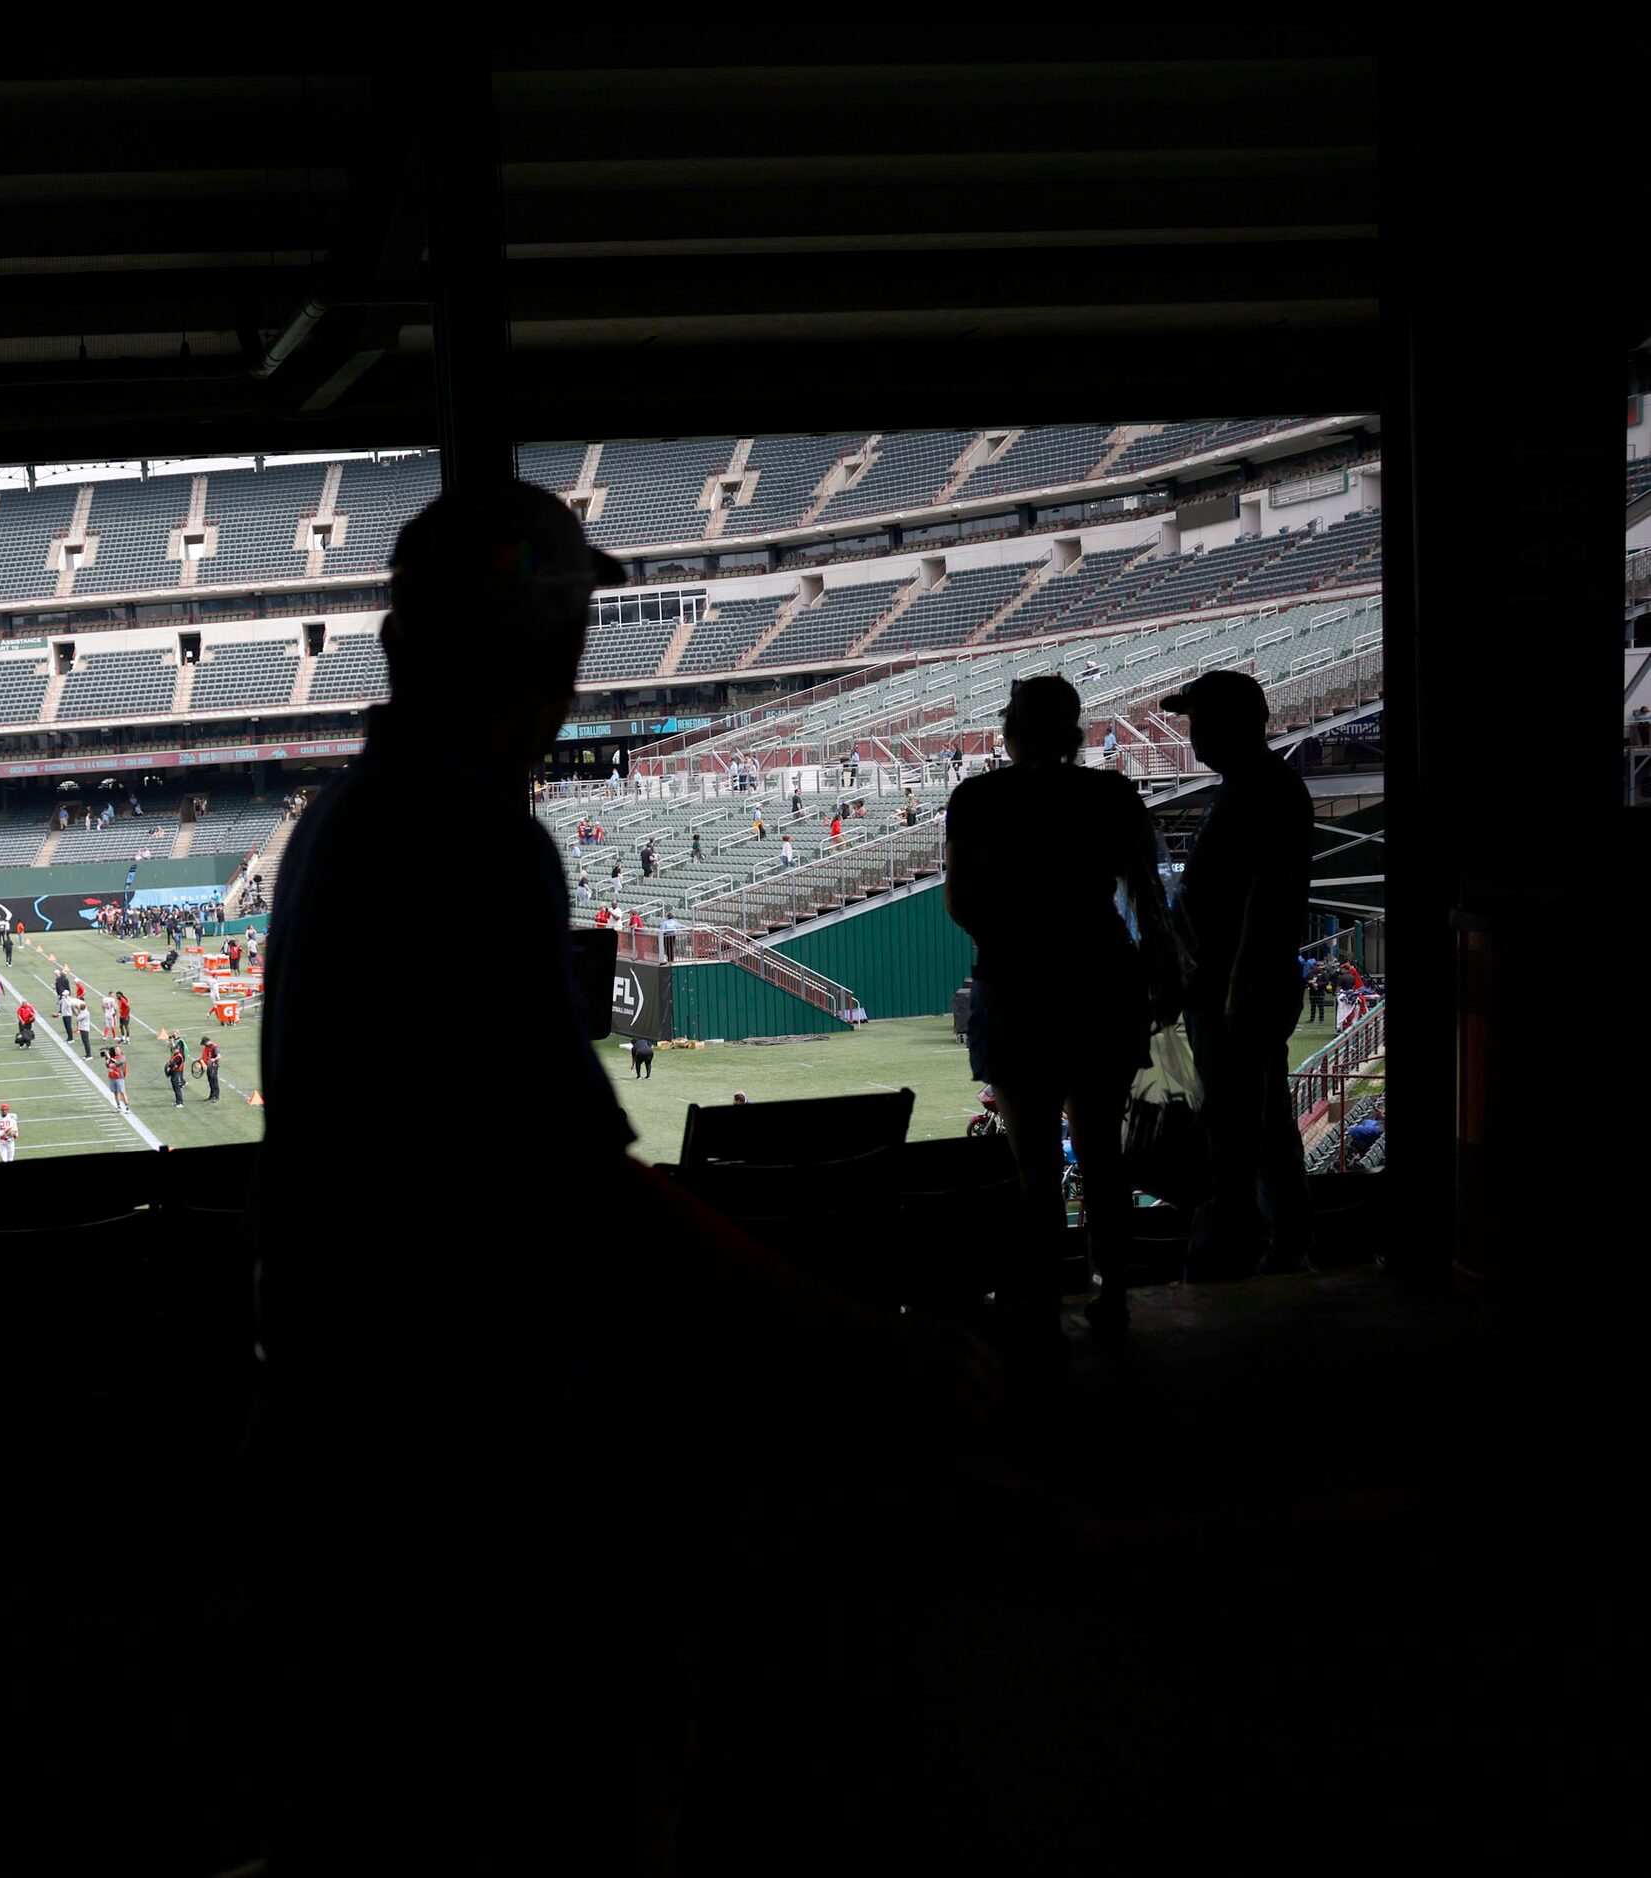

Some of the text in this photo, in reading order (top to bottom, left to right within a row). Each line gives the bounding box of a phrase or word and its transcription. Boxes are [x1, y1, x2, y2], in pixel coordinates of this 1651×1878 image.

[578, 725, 611, 737] STALLIONS
[613, 976, 635, 1006] FL
[223, 1006, 235, 1018] G
